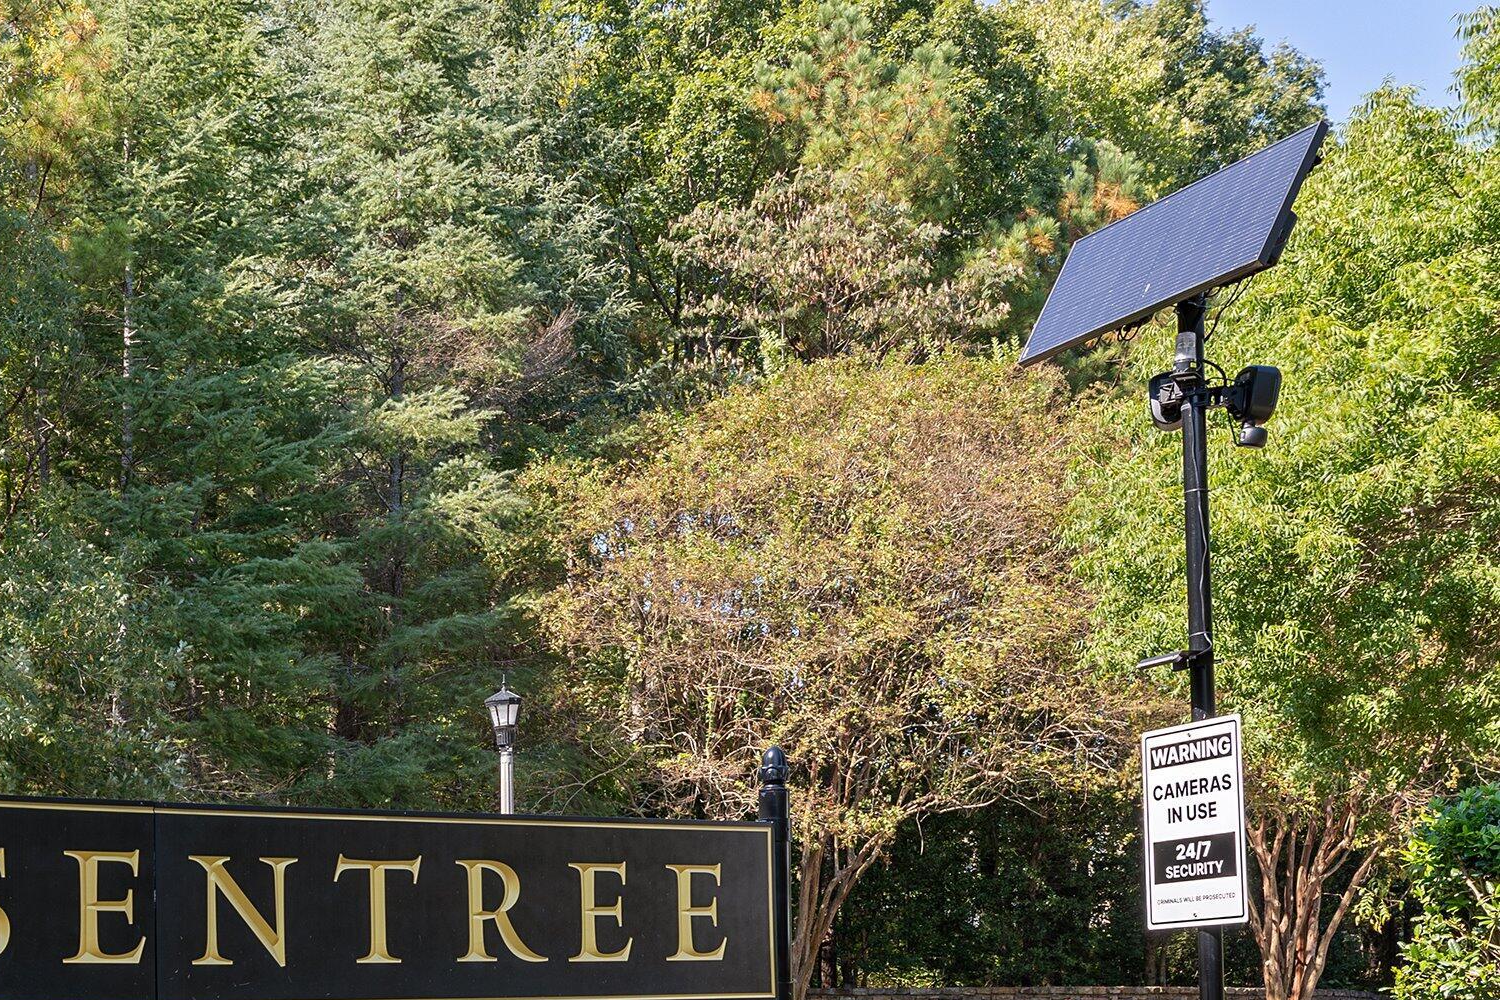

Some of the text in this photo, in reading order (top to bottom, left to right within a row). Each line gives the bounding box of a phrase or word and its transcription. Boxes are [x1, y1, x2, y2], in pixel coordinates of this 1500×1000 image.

[1152, 735, 1232, 767] WARNING
[1153, 774, 1232, 801] CAMERAS
[1167, 801, 1217, 824] IN USE
[1176, 840, 1212, 861] 24/7
[1165, 860, 1224, 879] SECURITY
[1157, 897, 1183, 905] CRIMINALS
[1183, 895, 1195, 903] WILL
[1202, 892, 1236, 901] PROSECUTED
